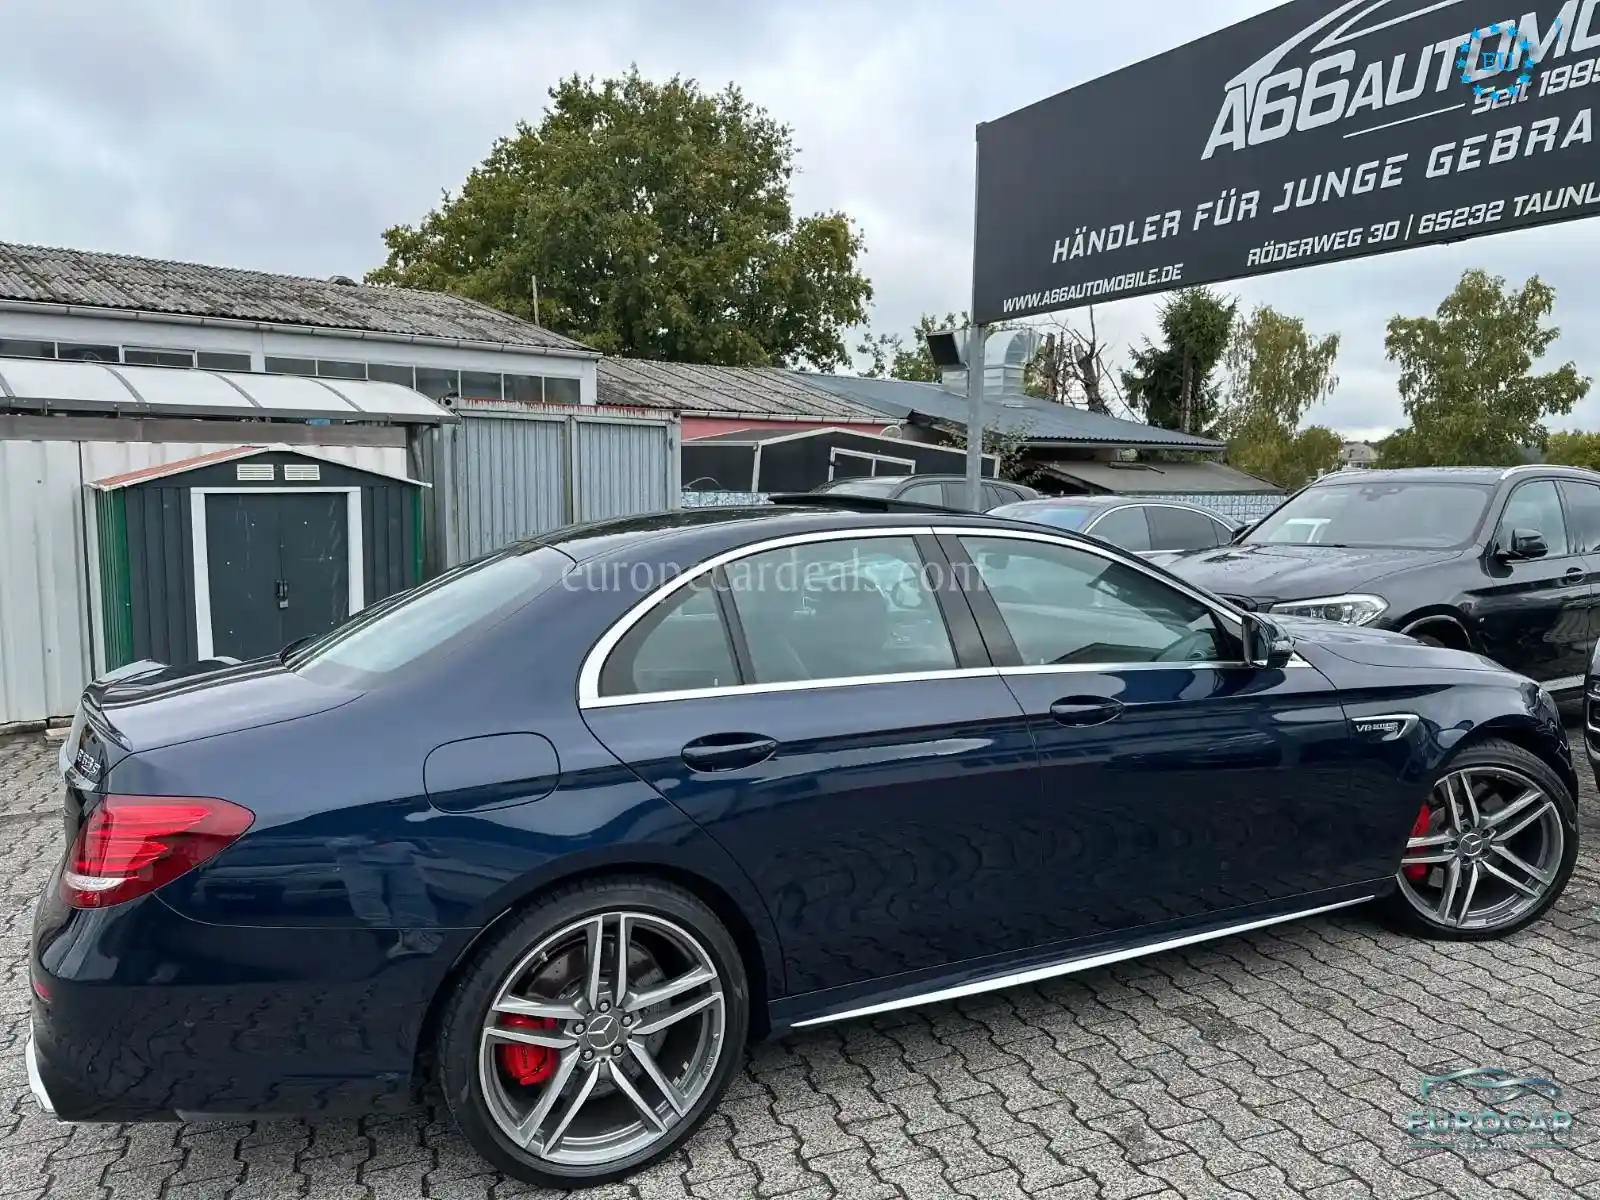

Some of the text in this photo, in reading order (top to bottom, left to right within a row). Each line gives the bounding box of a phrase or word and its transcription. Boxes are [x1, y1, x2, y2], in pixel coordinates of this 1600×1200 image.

[1052, 108, 1592, 264] HÄNDLER FÜR JUNGE GEBRA
[1247, 227, 1364, 267] RÖDERWEG
[1367, 220, 1401, 244] 30
[1418, 199, 1505, 235] 65232
[1003, 262, 1185, 313] WWW.A66AUTOMOBILE.DE
